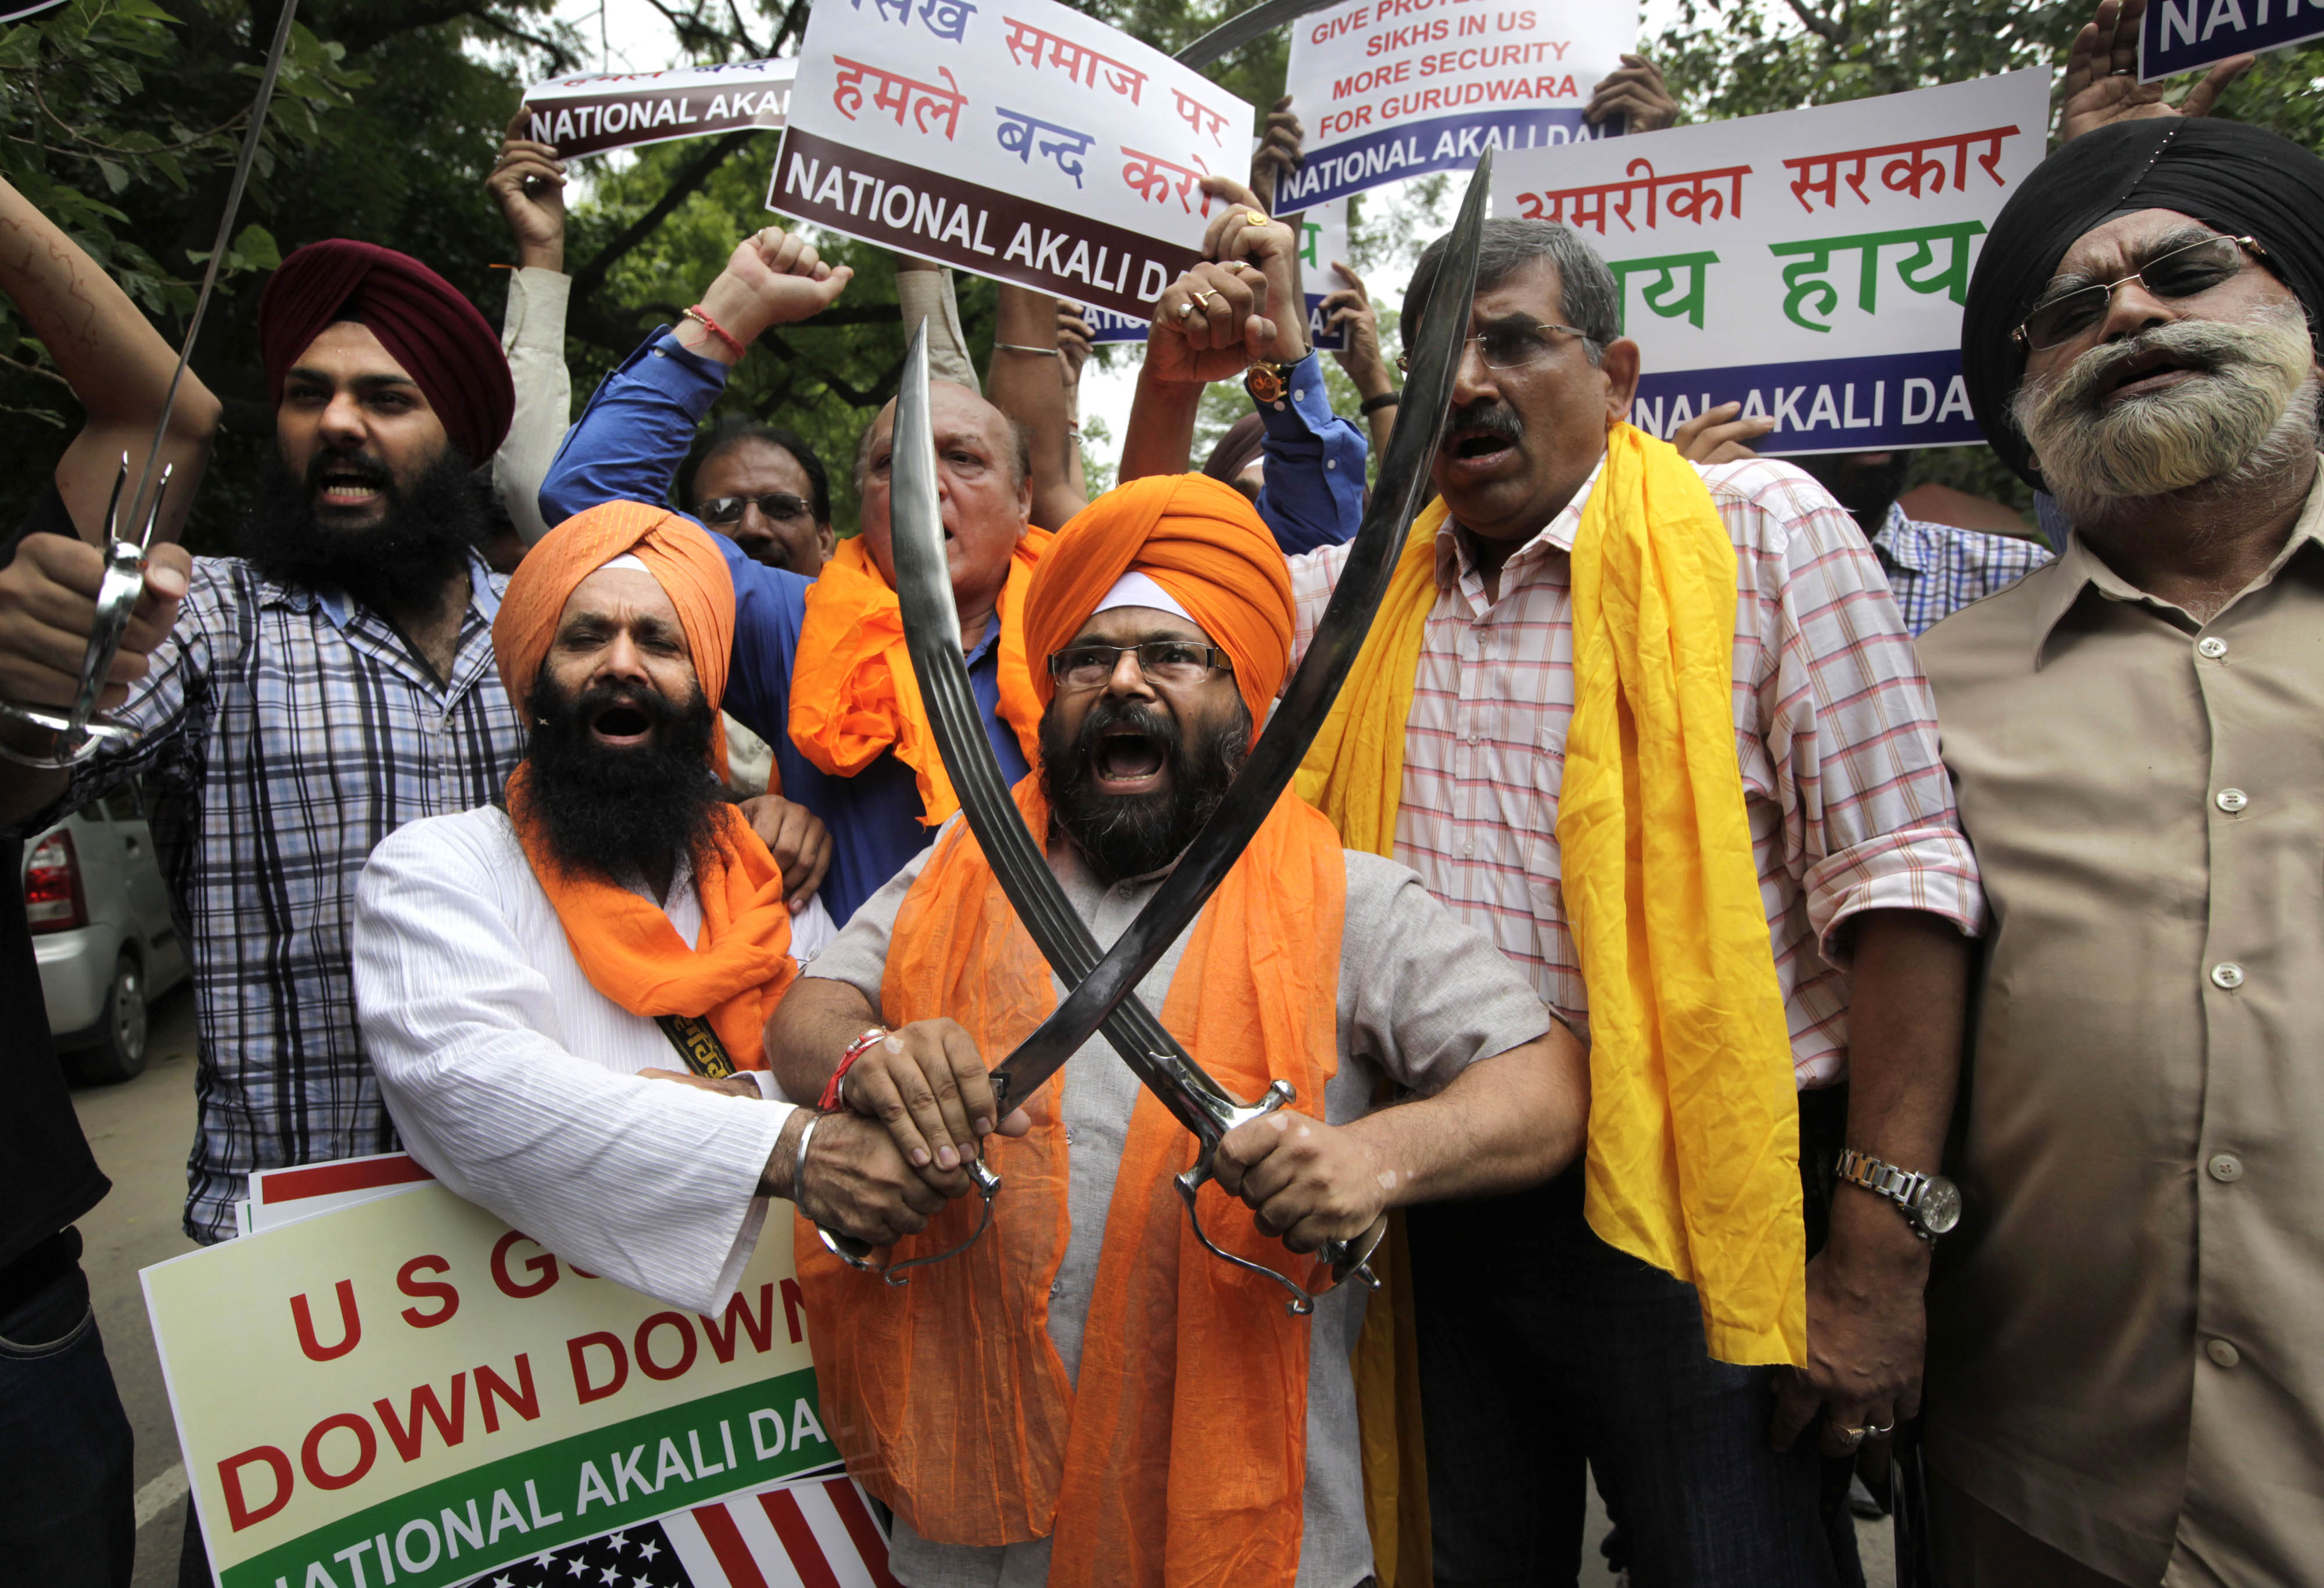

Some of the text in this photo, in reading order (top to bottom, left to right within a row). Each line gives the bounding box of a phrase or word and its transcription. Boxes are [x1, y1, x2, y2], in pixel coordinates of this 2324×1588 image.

[1311, 6, 1369, 45] GIVE
[1332, 41, 1571, 101] MORE SECURITY
[1366, 10, 1537, 57] SIKHS IN US
[530, 97, 698, 145] NATIONAL
[833, 54, 970, 143] हमले
[995, 106, 1096, 190] बन्द
[1002, 16, 1149, 107] समाज
[1170, 87, 1230, 148] पर
[1319, 74, 1579, 139] FOR GURUDWARA
[1282, 136, 1426, 202] NATIONAL
[1516, 124, 2021, 235] अमरीका सरकार
[784, 152, 1190, 303] NATIONAL AKALI D
[1768, 220, 1988, 333] हाय
[1741, 380, 1884, 433] AKALI
[290, 1279, 361, 1361] U
[396, 1254, 460, 1329] S
[217, 1353, 540, 1533] DOWN
[576, 1420, 734, 1515] AKALI
